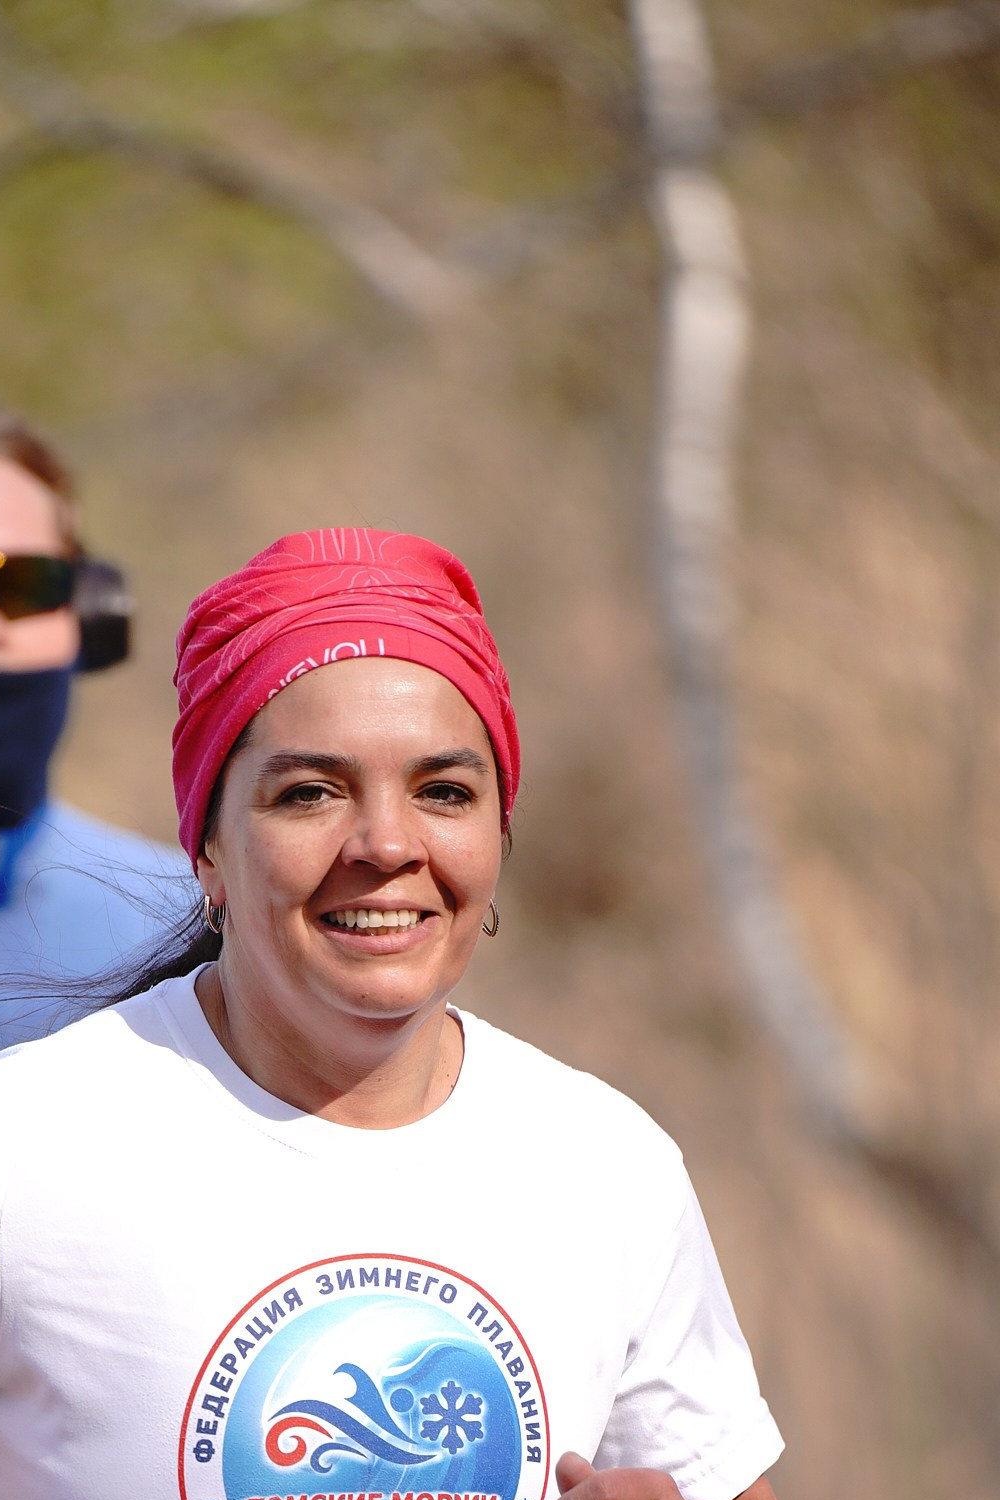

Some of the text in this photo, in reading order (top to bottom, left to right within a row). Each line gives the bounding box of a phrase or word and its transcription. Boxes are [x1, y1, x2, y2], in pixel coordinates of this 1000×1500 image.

[192, 1267, 542, 1463] ФЕДЕРАЦИЯ ЗИМНЕГО ПЛАВАНИЯ
